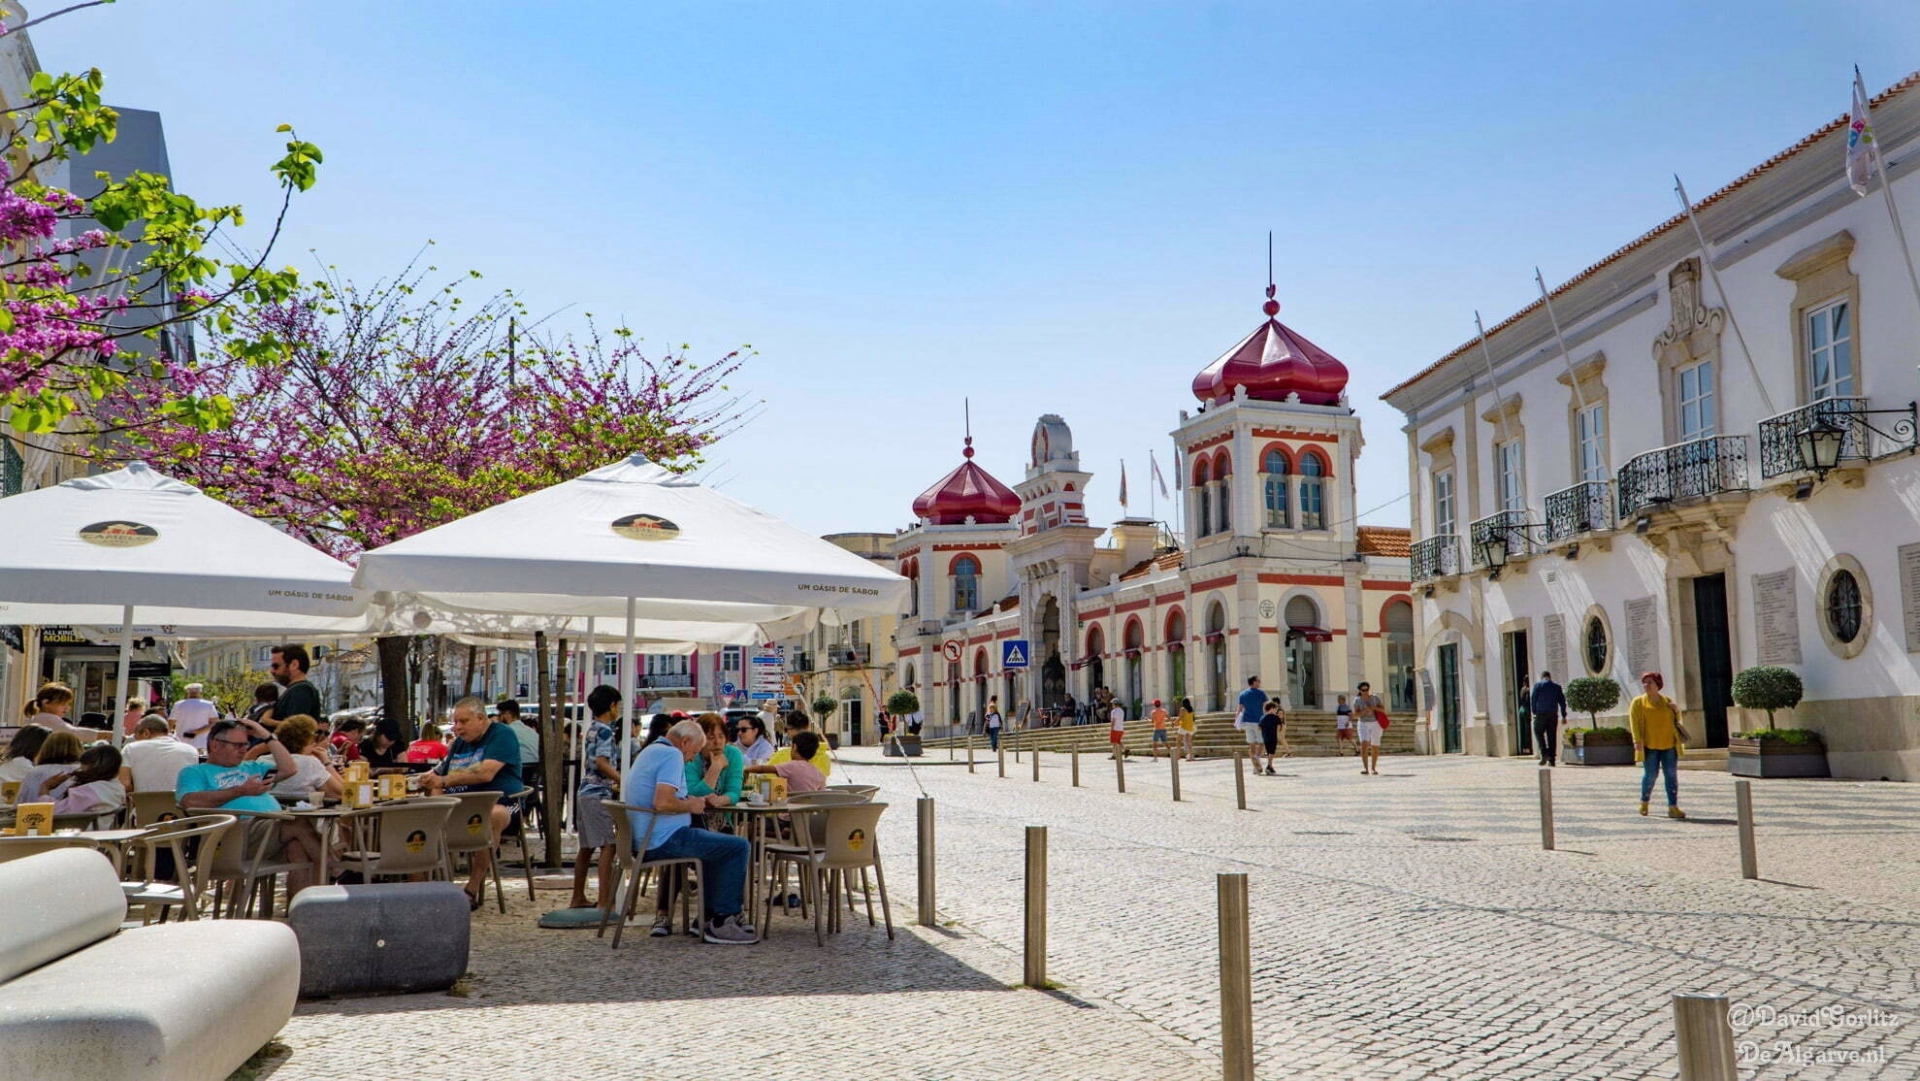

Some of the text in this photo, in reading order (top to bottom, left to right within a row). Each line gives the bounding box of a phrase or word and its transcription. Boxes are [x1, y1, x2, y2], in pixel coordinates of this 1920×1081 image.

[284, 589, 309, 598] OÁSIS
[325, 593, 354, 602] SABOR
[812, 583, 836, 592] OÁSIS
[851, 587, 879, 596] SABOR
